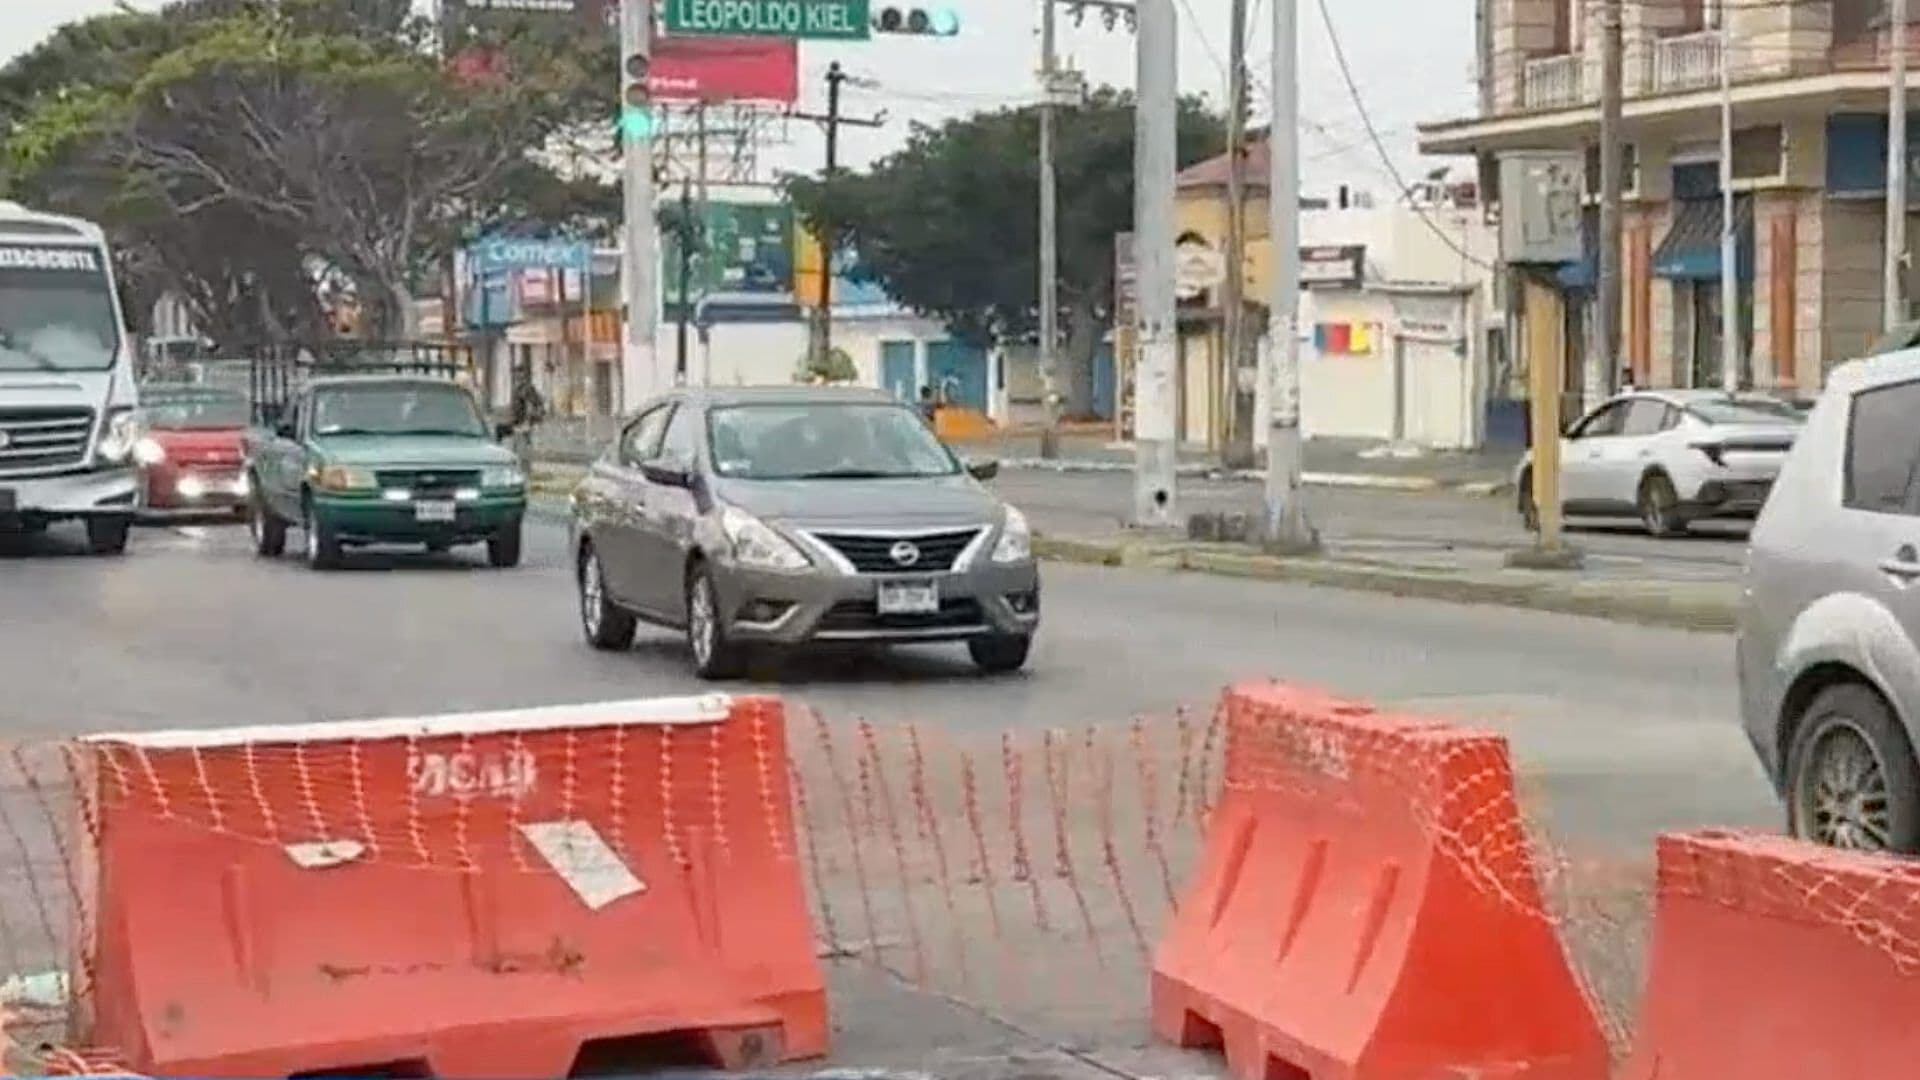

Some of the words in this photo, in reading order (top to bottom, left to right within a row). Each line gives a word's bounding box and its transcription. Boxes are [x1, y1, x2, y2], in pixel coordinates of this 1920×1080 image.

[678, 0, 800, 31] LEOPOLDO
[806, 4, 855, 31] KIEL
[488, 240, 576, 264] Comex
